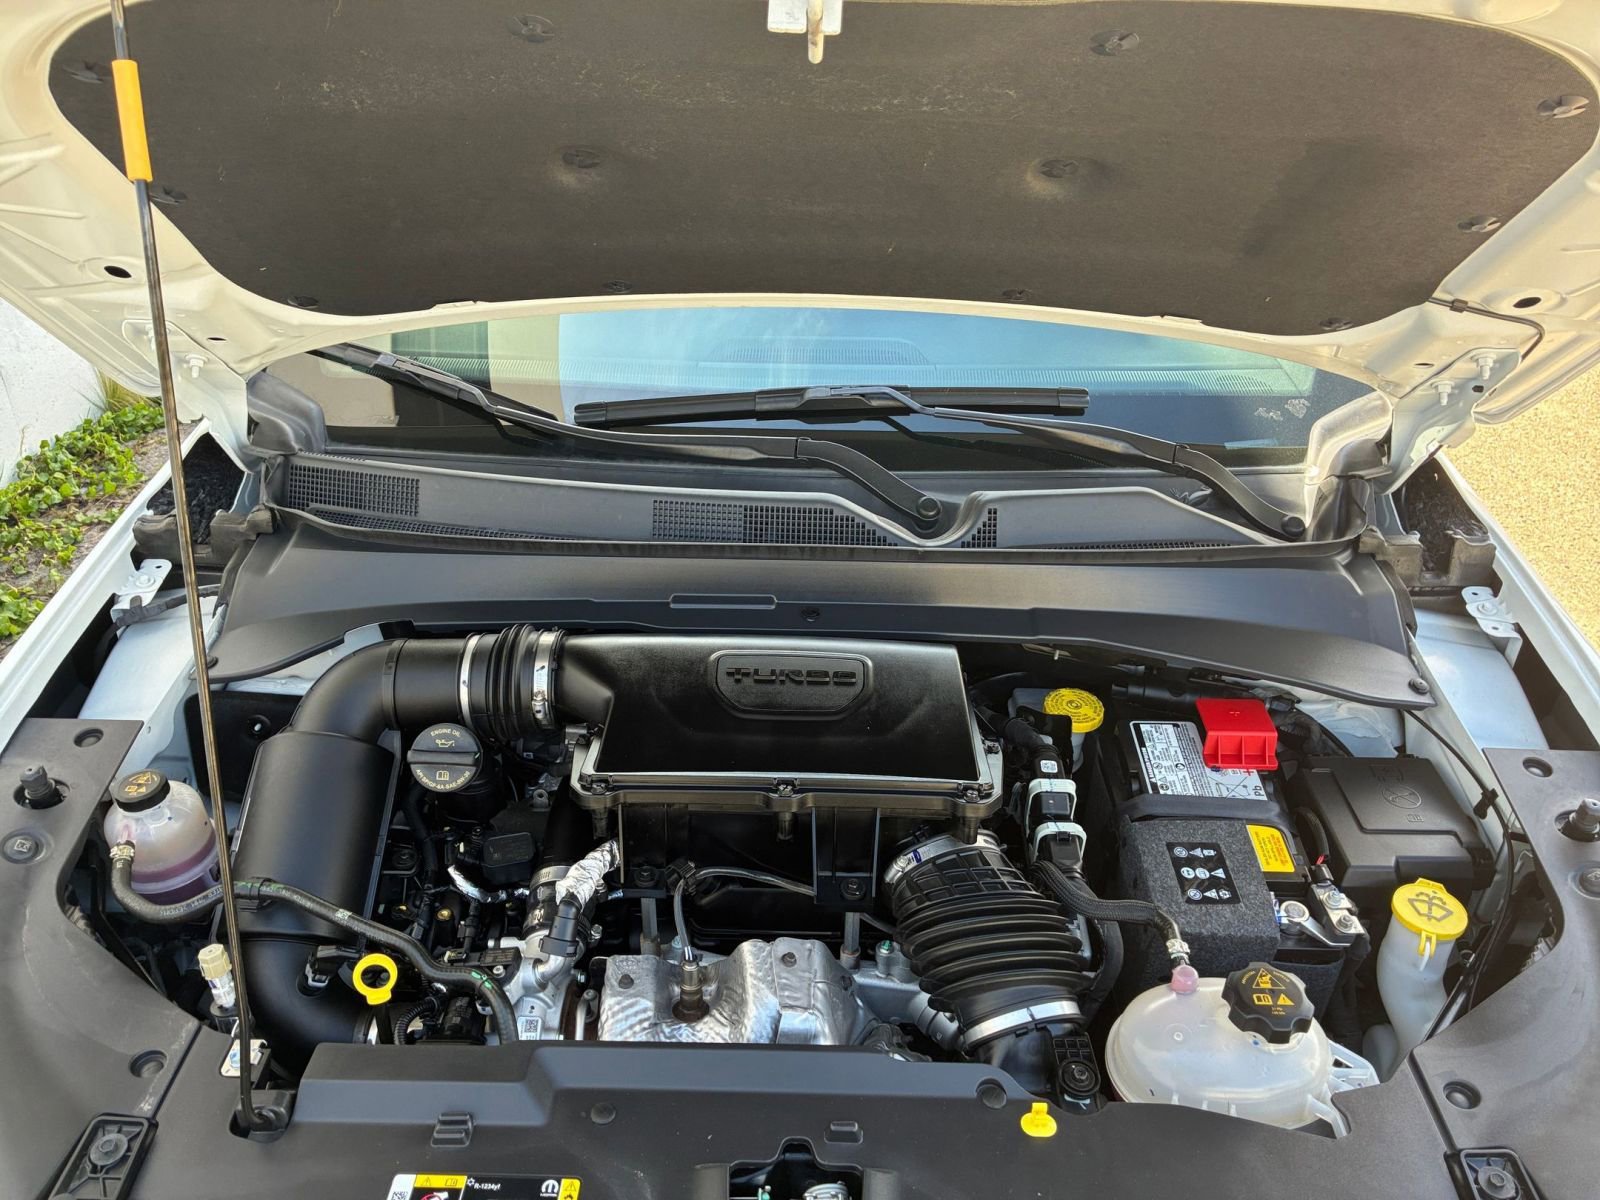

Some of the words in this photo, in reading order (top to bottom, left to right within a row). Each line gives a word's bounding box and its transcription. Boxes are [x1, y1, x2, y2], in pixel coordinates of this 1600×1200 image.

[431, 728, 451, 737] ENGINE
[452, 730, 460, 738] OIL
[1252, 785, 1265, 797] Pb
[474, 1183, 500, 1191] R-1234yf
